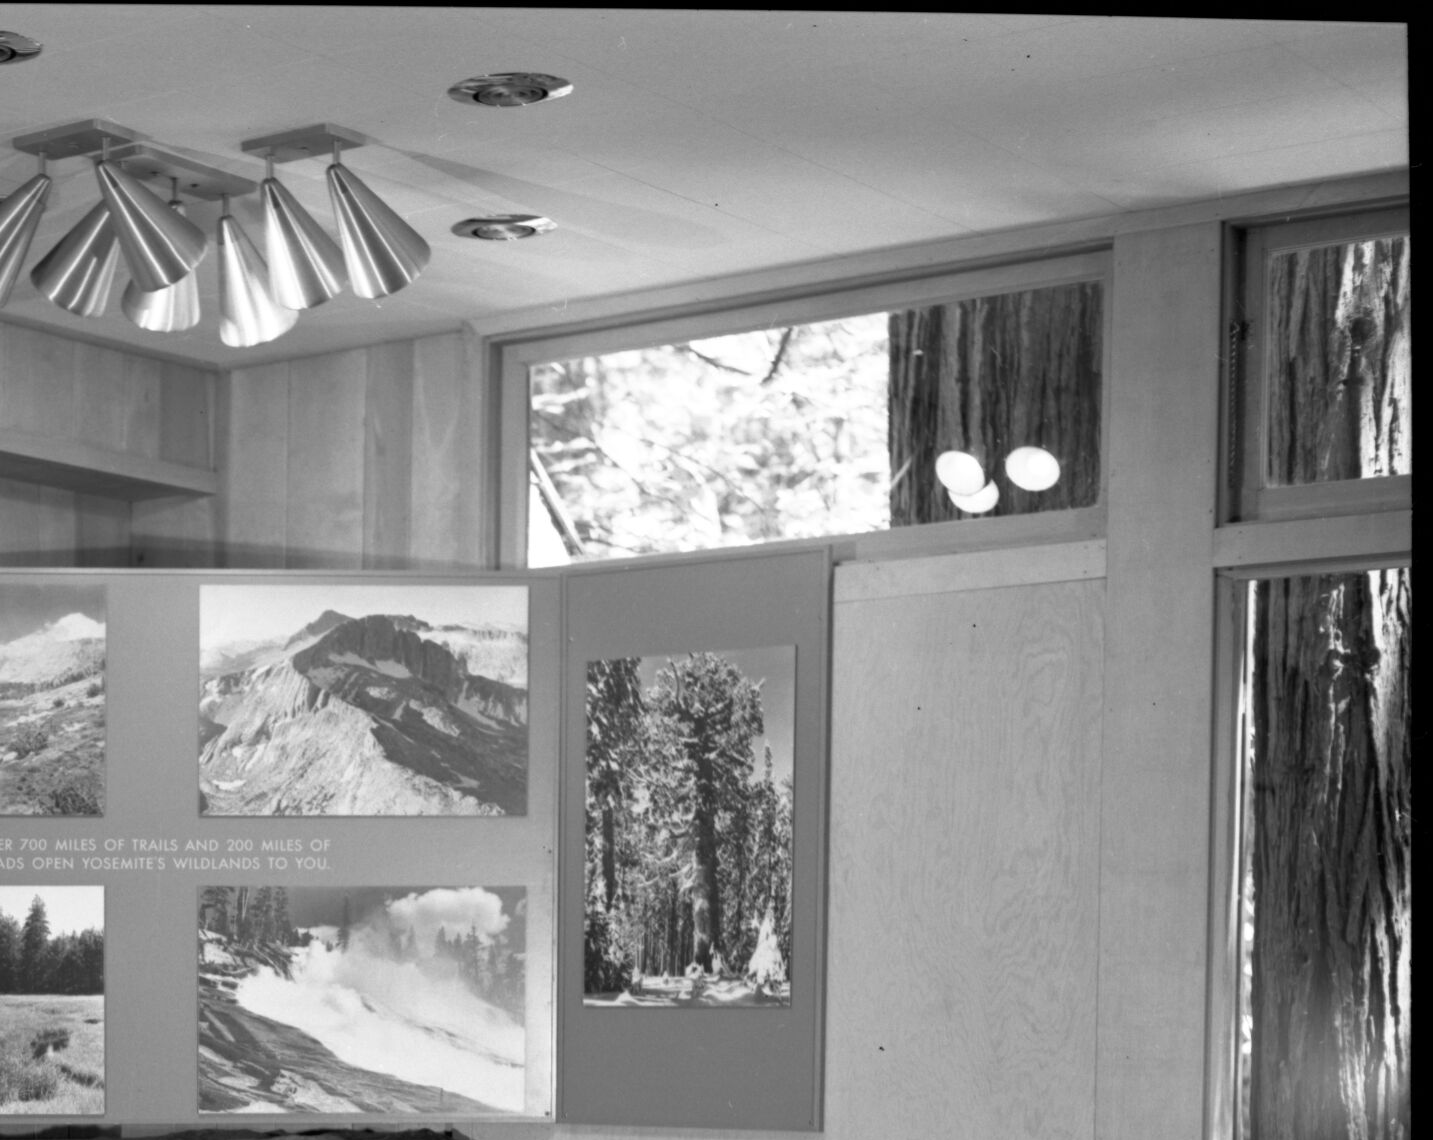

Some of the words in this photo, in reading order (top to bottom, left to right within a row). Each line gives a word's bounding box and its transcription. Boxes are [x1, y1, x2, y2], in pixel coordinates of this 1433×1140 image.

[19, 838, 48, 852] 700
[55, 838, 97, 852] MILES
[103, 838, 125, 852] OF
[131, 838, 179, 852] TRAILS
[184, 839, 219, 852] AND
[226, 838, 254, 852] 200
[260, 838, 304, 852] MILES
[309, 838, 331, 852] OF
[31, 856, 74, 870] OPEN
[81, 856, 166, 871] YOSEMITE'S
[172, 856, 261, 870] WILDLANDS
[267, 856, 289, 871] TO
[294, 856, 331, 871] YOU.
